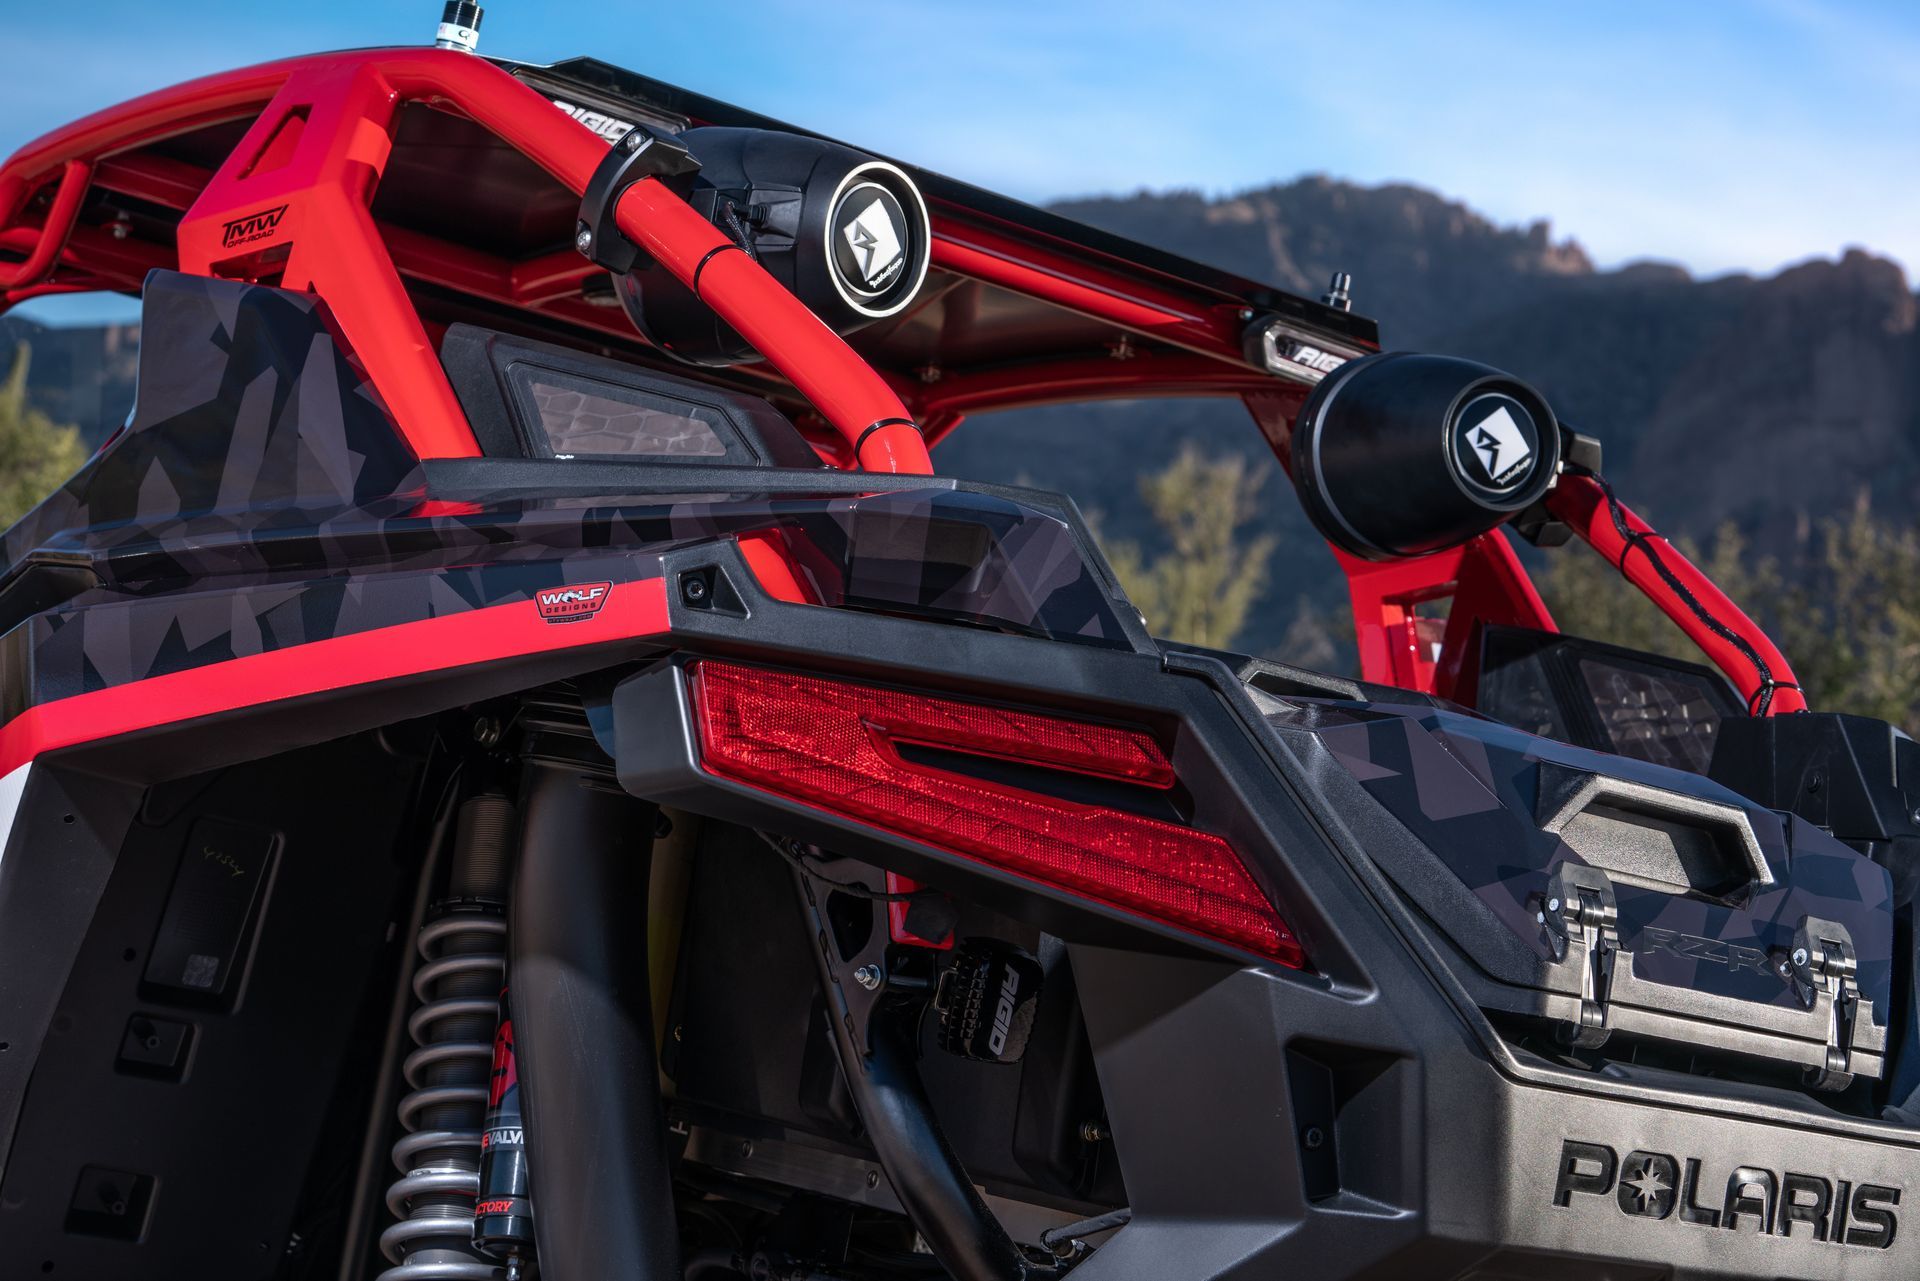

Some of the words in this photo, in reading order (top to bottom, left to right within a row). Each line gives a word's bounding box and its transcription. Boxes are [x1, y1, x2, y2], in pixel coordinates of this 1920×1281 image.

[222, 204, 289, 248] TMW
[546, 602, 596, 614] DESIGNS
[1643, 925, 1773, 977] RZR
[988, 962, 1020, 1056] RIGID
[1552, 1139, 1902, 1249] POLARIS
